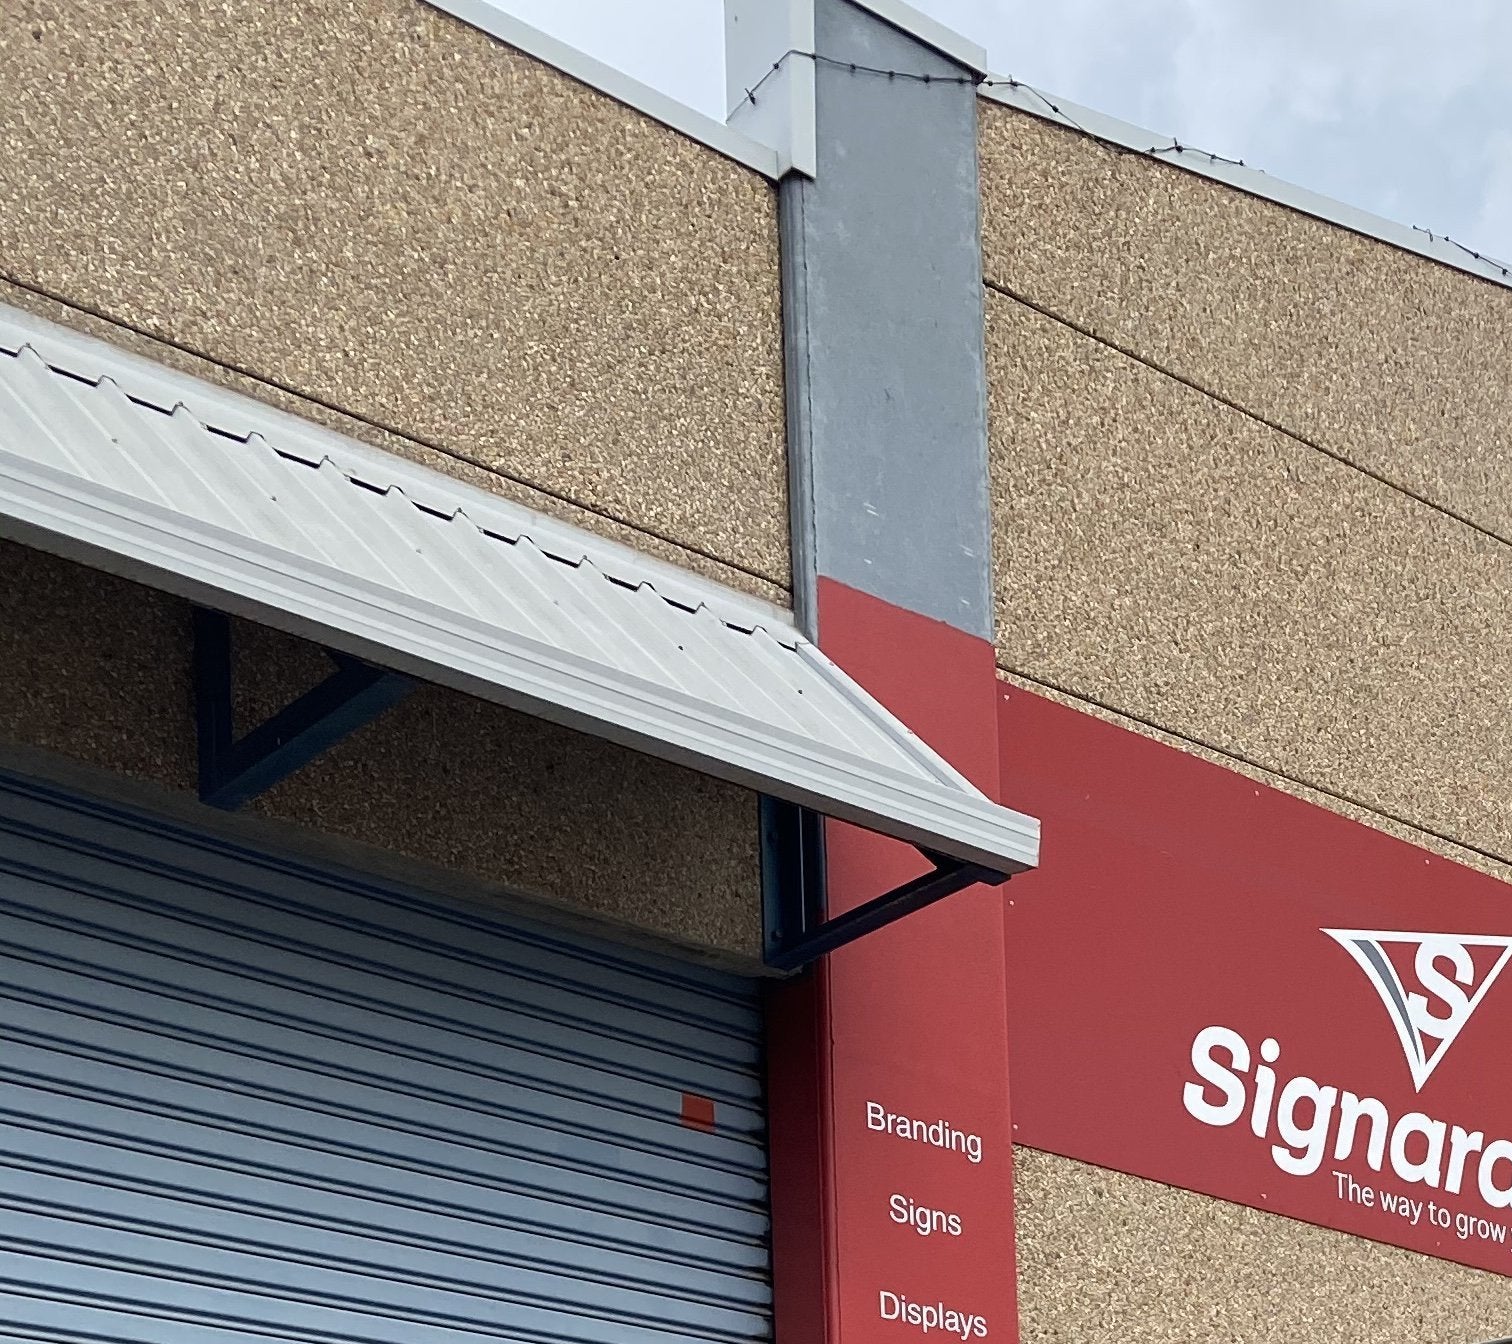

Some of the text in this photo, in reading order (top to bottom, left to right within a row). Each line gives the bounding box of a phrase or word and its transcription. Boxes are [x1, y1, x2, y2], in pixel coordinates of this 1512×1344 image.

[866, 1101, 983, 1163] Branding
[889, 1194, 962, 1236] Signs
[1332, 1171, 1374, 1206] The
[1380, 1189, 1423, 1225] way
[1428, 1203, 1451, 1229] to
[1456, 1213, 1506, 1243] grow
[879, 1291, 988, 1341] Displays
